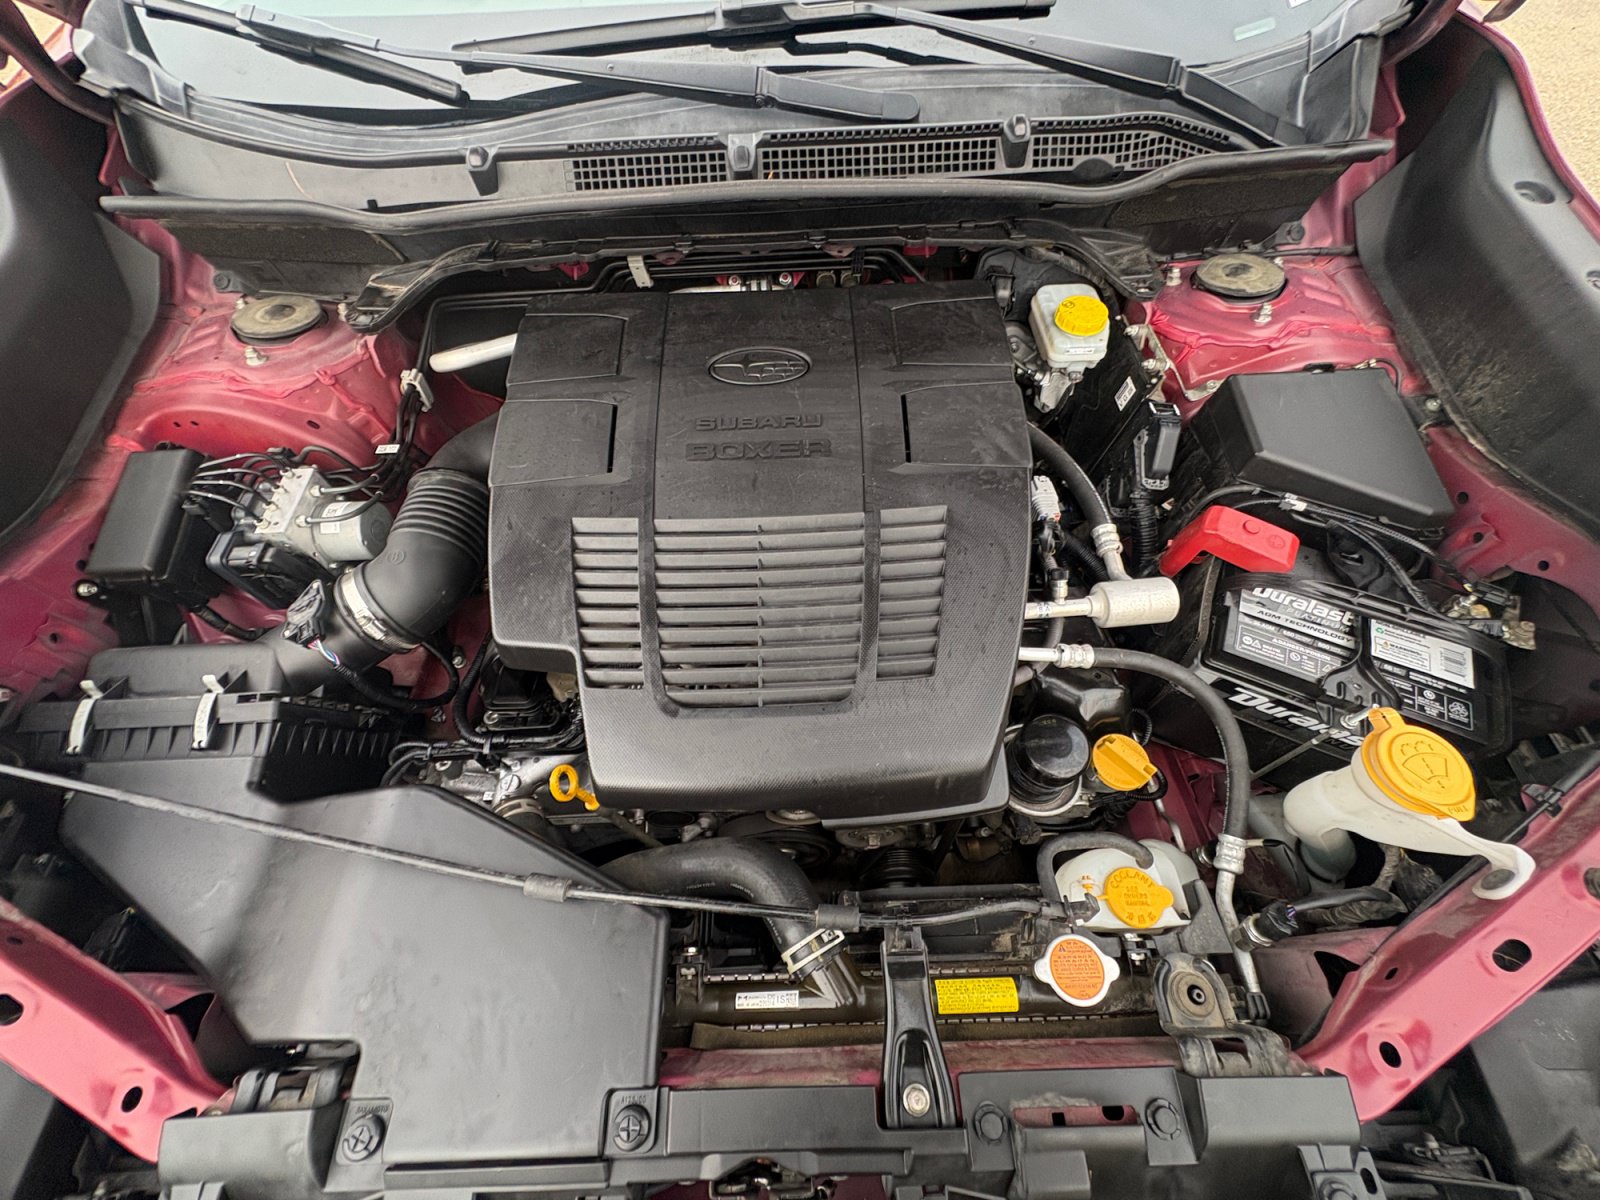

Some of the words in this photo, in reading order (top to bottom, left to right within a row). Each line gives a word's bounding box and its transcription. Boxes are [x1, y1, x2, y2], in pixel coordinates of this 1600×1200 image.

[695, 414, 823, 431] SUBARU
[685, 439, 833, 461] BOXER
[1252, 587, 1355, 626] Duralast
[1256, 610, 1281, 621] AGM
[1284, 617, 1353, 643] TECHNOLOGY
[1228, 687, 1366, 746] Duralas
[1109, 869, 1156, 889] COOLANT
